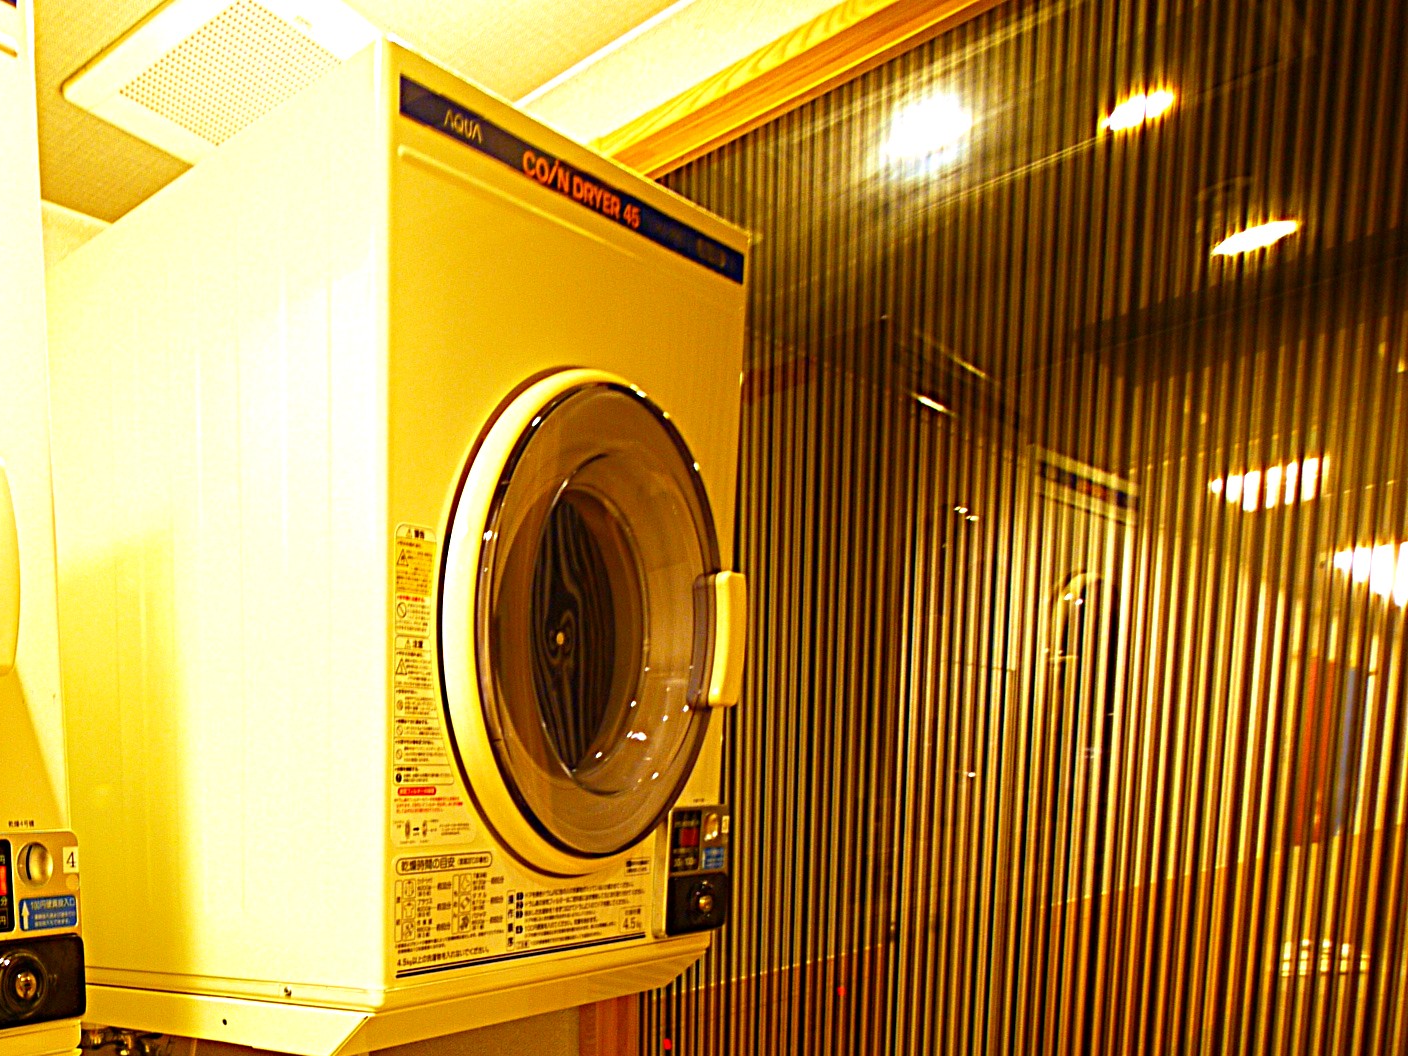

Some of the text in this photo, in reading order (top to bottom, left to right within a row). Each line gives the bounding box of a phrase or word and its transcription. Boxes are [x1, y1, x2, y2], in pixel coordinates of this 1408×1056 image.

[444, 108, 484, 144] AQUA
[572, 176, 622, 220] DRYER
[623, 203, 641, 229] 45
[66, 851, 77, 868] 4
